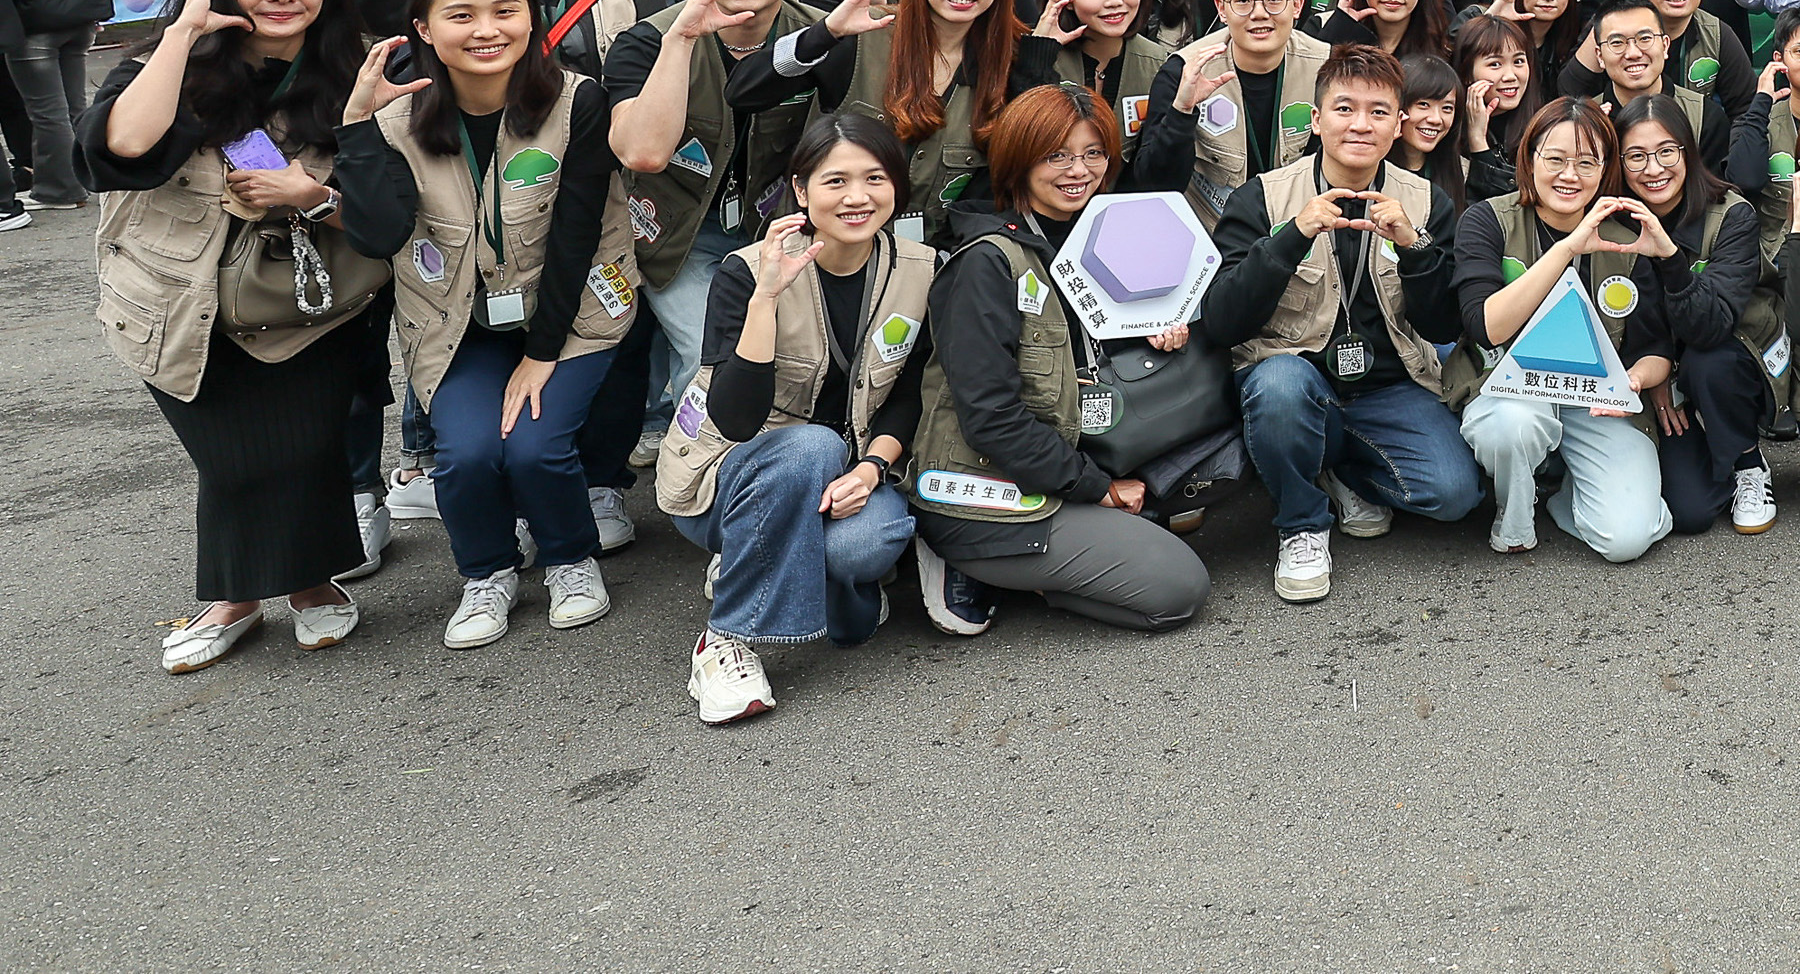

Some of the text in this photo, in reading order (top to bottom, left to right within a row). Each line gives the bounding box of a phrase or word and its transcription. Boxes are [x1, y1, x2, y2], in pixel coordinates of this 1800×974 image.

[1056, 259, 1109, 329] 財投精算
[1121, 321, 1154, 330] FINANCE
[1163, 296, 1193, 327] ACTUARIAL
[1190, 266, 1209, 296] SCIENCE
[1524, 371, 1598, 394] 數位科技
[1490, 385, 1630, 407] DIGITAL INFORMATION TECHNOLOGY
[929, 478, 1017, 502] 國泰共生圈
